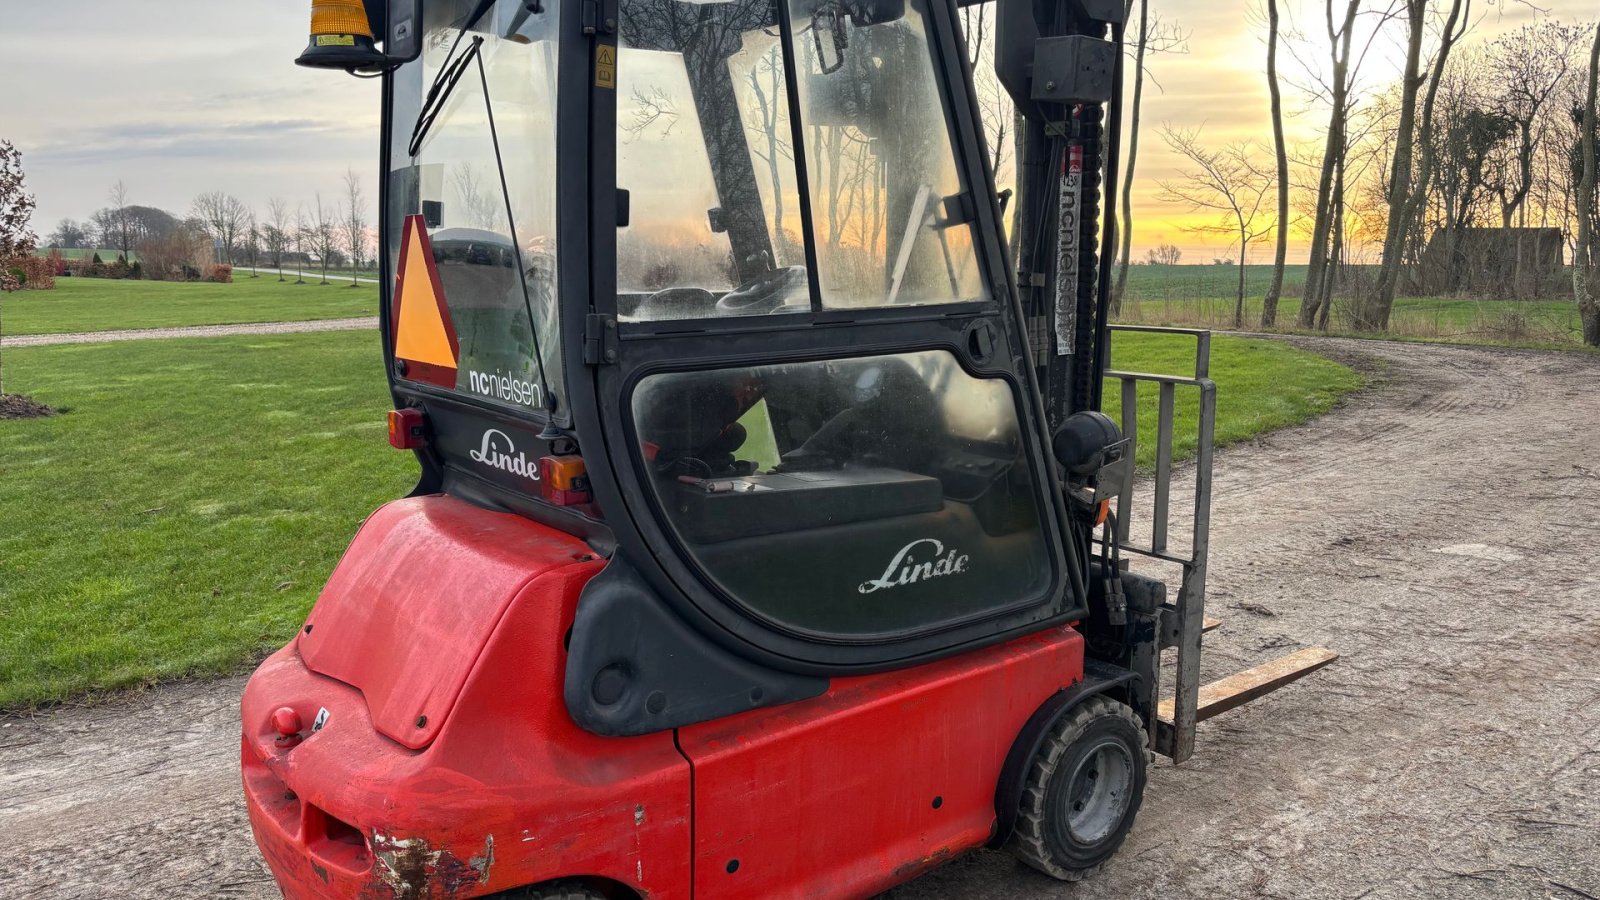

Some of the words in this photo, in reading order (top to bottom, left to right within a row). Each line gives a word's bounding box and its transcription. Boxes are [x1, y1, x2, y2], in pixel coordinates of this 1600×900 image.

[469, 370, 541, 408] ncnielsen
[470, 428, 540, 481] Linde
[858, 538, 969, 594] Linde
